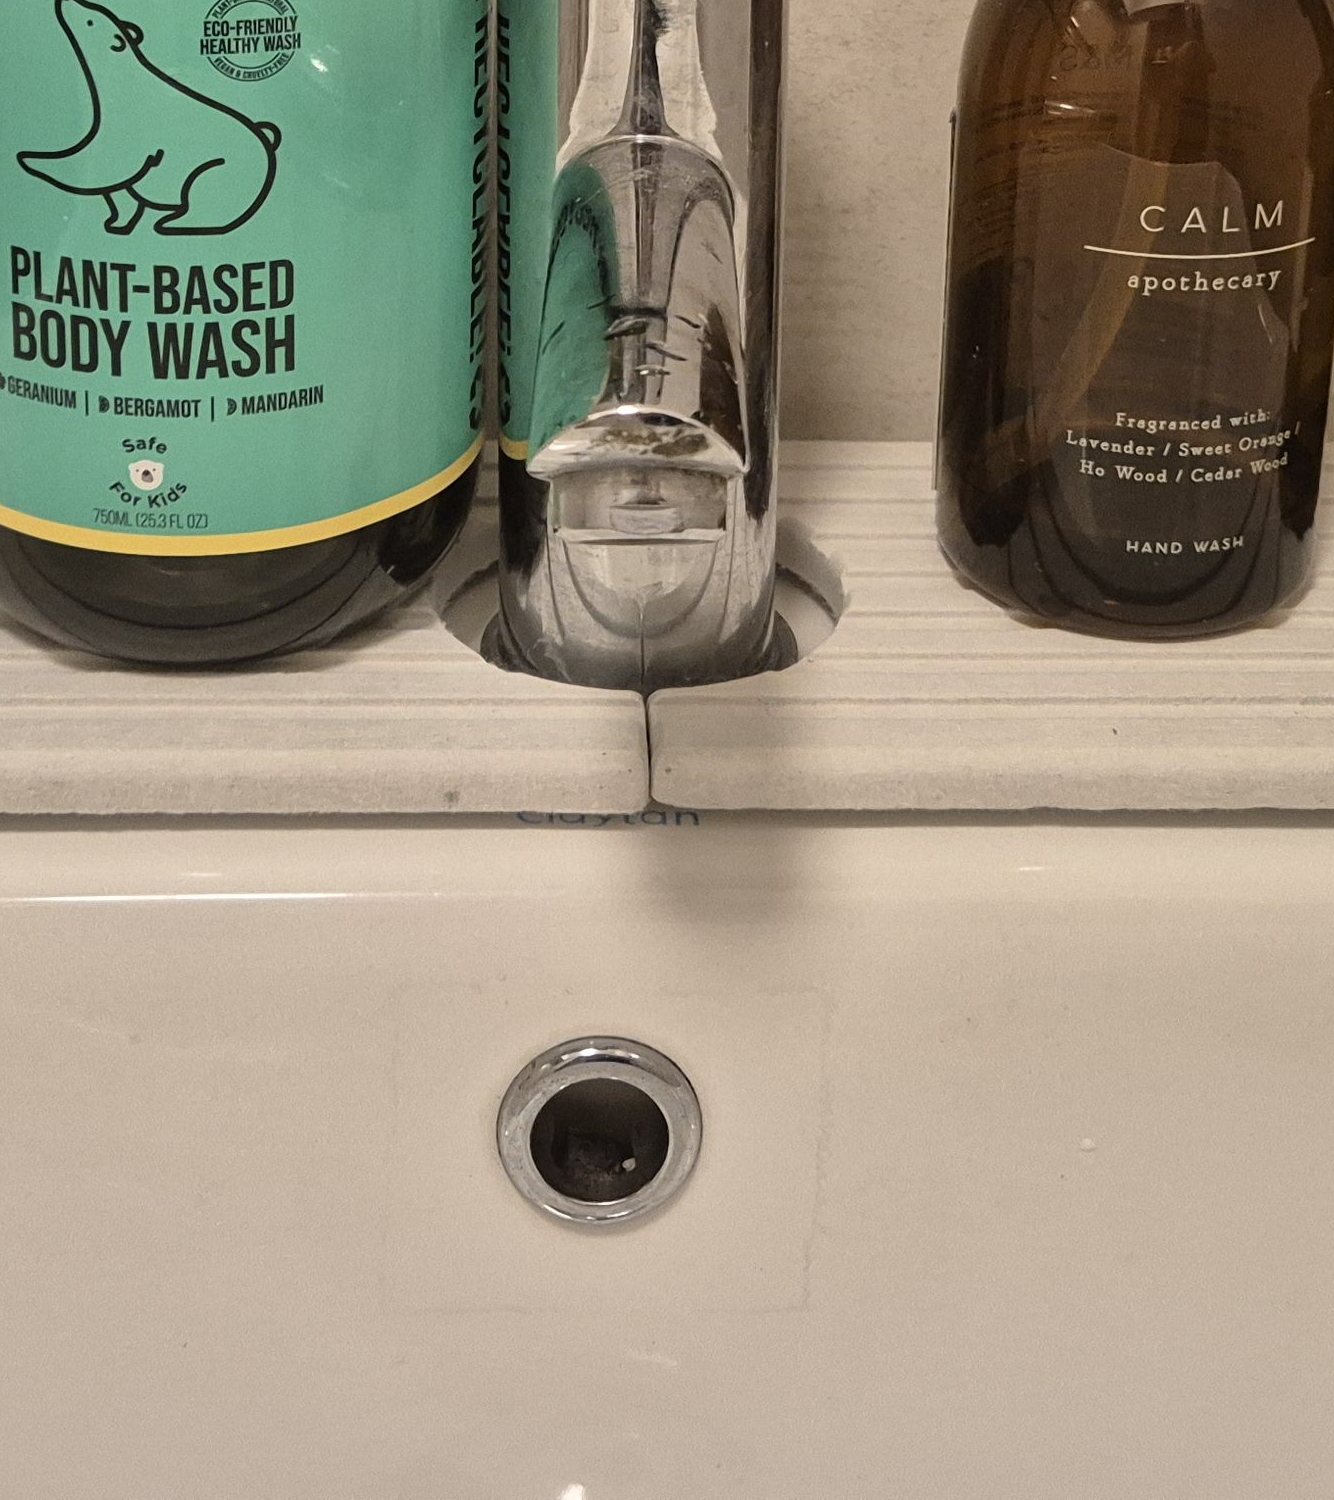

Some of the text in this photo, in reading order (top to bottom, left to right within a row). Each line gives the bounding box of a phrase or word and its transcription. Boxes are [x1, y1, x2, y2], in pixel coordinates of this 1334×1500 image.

[203, 15, 298, 37] ECO-FRIENDLY
[199, 32, 301, 55] HEALTHY WASH
[213, 57, 236, 76] VEGAN
[242, 52, 290, 79] CRUELTY-FREE
[1139, 200, 1284, 234] CALM
[10, 244, 295, 315] PLANT-BASED
[1127, 270, 1282, 296] apothecary
[11, 301, 296, 380] BODY WASH
[7, 374, 324, 419] GERANIUM BERGAMOT MANDARIN
[1115, 412, 1222, 434] Fragranced
[121, 436, 167, 455] Safe
[1066, 430, 1156, 456] Lavender
[1178, 442, 1232, 457] Sweet
[1238, 429, 1291, 451] Orange
[1079, 459, 1105, 477] Ho
[1116, 465, 1168, 483] Wood
[1190, 468, 1243, 483] Cedar
[1250, 452, 1289, 475] Wood
[109, 481, 187, 509] For Kids
[92, 508, 133, 527] 750ML
[169, 513, 184, 529] FL
[1125, 536, 1244, 555] HAND WASH
